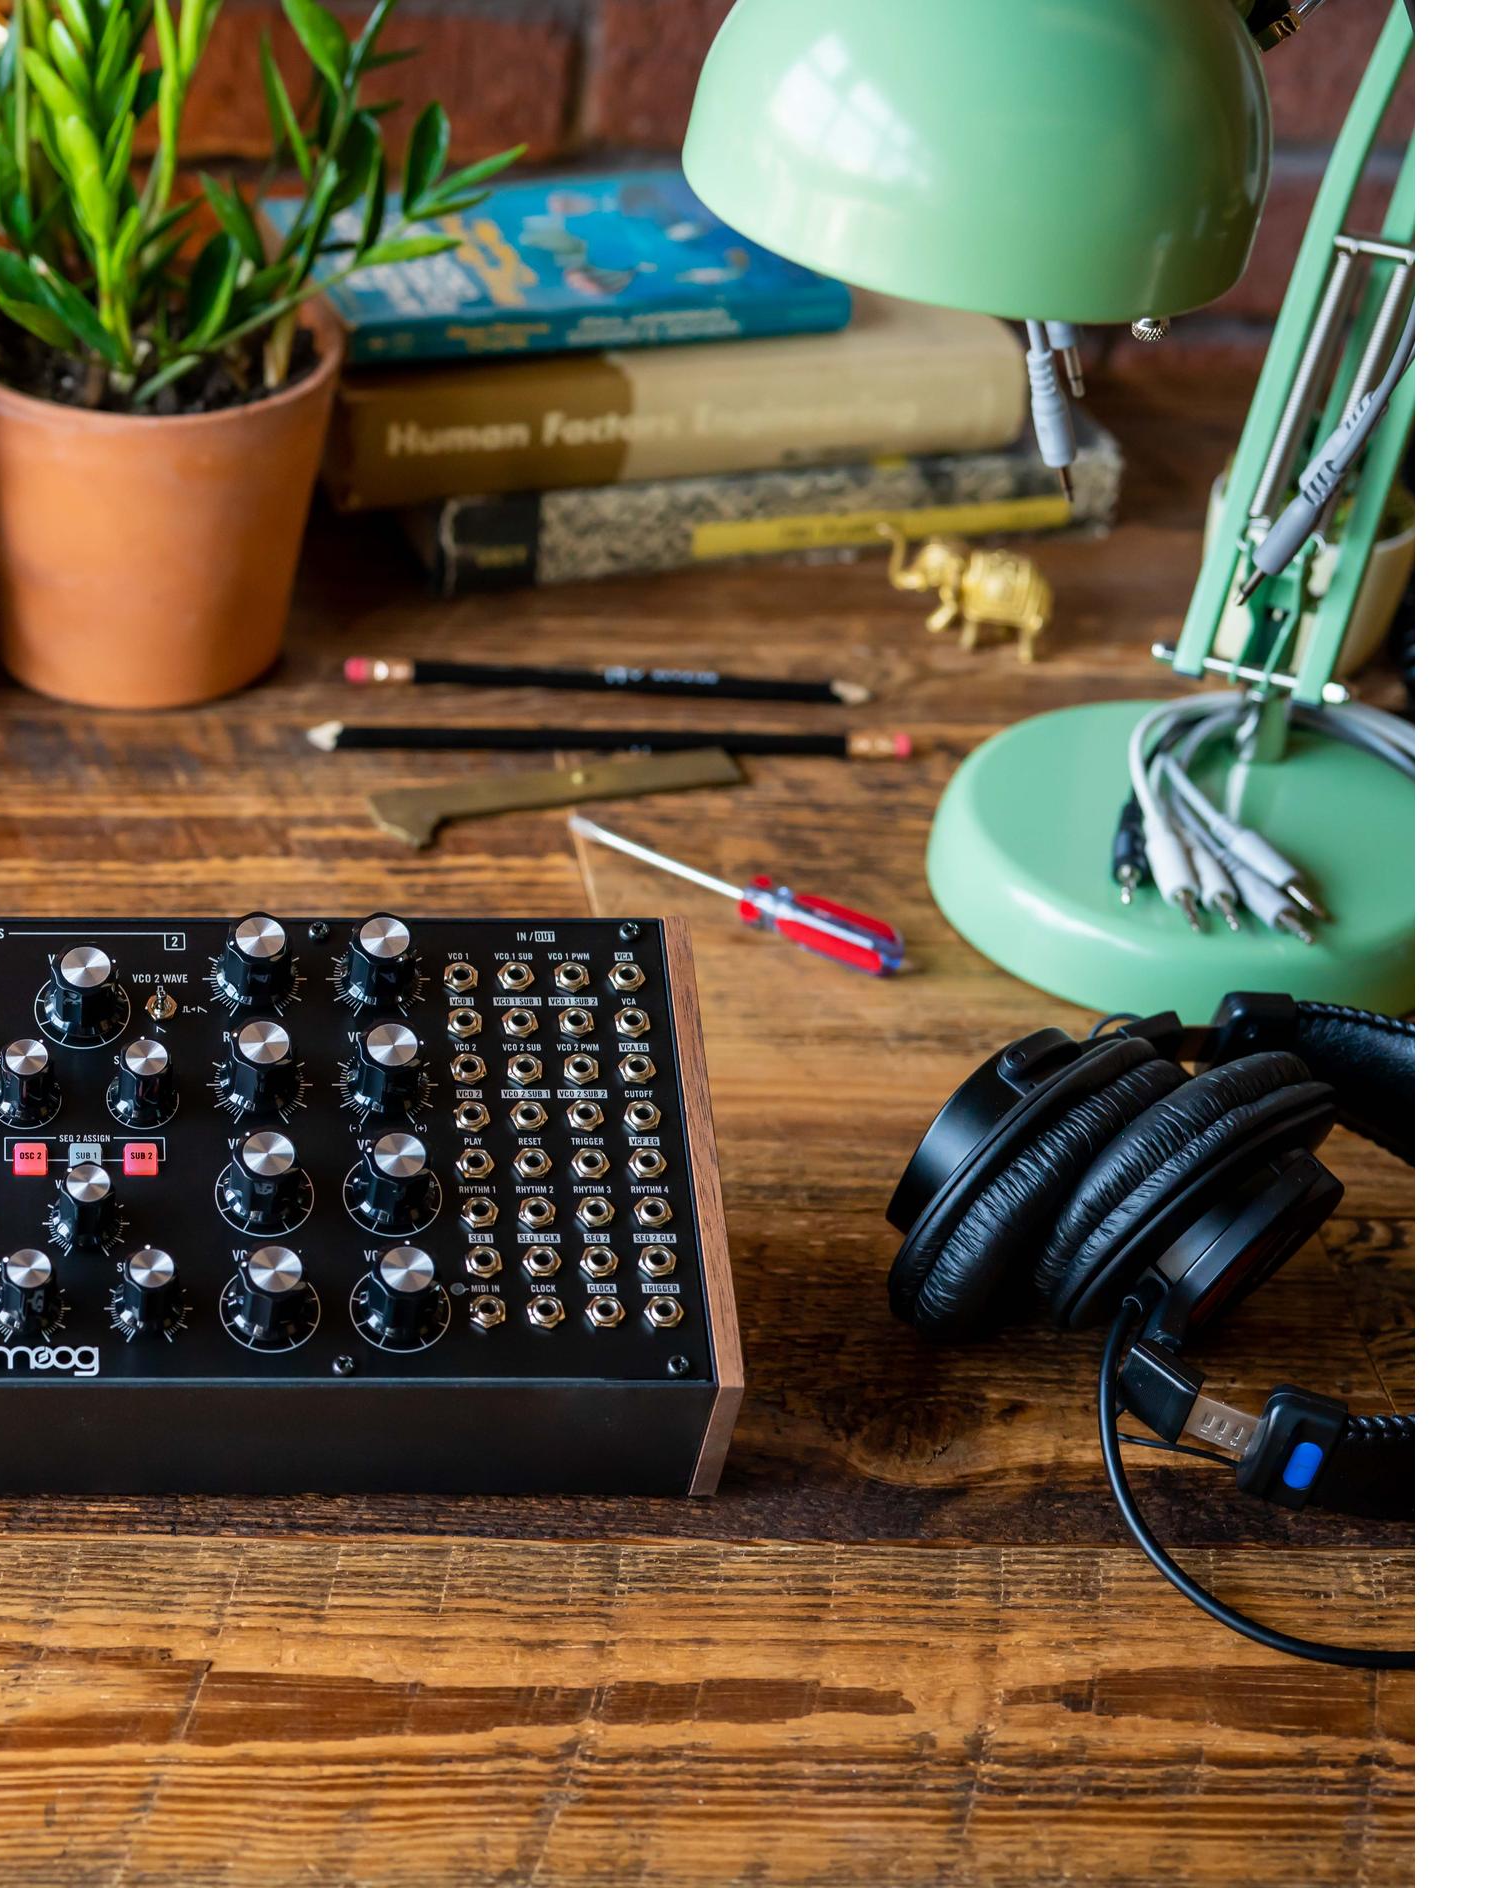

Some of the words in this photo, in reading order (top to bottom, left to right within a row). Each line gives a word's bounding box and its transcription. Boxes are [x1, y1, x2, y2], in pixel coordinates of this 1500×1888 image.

[387, 419, 529, 458] Human
[516, 932, 528, 942] IN
[536, 932, 554, 942] OUT
[132, 974, 151, 983] VCO
[154, 974, 160, 983] 2
[163, 974, 188, 983] WAVE
[458, 1090, 474, 1098] VCO
[475, 1090, 481, 1098] 2
[503, 1090, 519, 1098] VCO
[520, 1090, 526, 1098] 2
[527, 1090, 543, 1098] SUB
[545, 1090, 549, 1098] 1
[559, 1090, 575, 1098] VCO
[576, 1090, 582, 1098] 2
[583, 1090, 599, 1098] SUB
[600, 1090, 606, 1098] 2
[624, 1090, 653, 1098] CUTOFF
[59, 1134, 75, 1143] SEQ
[76, 1134, 81, 1142] 2
[83, 1134, 111, 1142] ASSIGN
[464, 1138, 483, 1146] PLAY
[518, 1138, 542, 1146] RESET
[571, 1138, 604, 1146] TRIGGER
[630, 1138, 646, 1146] VCF
[647, 1138, 658, 1146] EG
[19, 1152, 35, 1160] OSC
[36, 1152, 42, 1160] 2
[75, 1152, 91, 1160] SUB
[93, 1152, 97, 1160] 1
[130, 1152, 146, 1160] SUB
[147, 1152, 153, 1160] 2
[459, 1186, 490, 1194] RHYTHM
[492, 1186, 496, 1194] 1
[515, 1186, 547, 1194] RHYTHM
[548, 1186, 554, 1194] 2
[573, 1186, 604, 1194] RHYTHM
[605, 1186, 611, 1194] 3
[630, 1186, 662, 1194] RHYTHM
[663, 1186, 669, 1194] 4
[470, 1234, 486, 1242] SEQ
[488, 1234, 493, 1242] 1
[519, 1234, 535, 1242] SEQ
[537, 1234, 541, 1242] 1
[544, 1234, 559, 1242] CLK
[586, 1234, 601, 1242] SEQ
[603, 1234, 609, 1242] 2
[635, 1234, 651, 1242] SEQ
[652, 1234, 658, 1242] 2
[660, 1234, 675, 1242] CLK
[471, 1285, 489, 1293] MIDI
[491, 1285, 500, 1293] IN
[531, 1285, 556, 1293] CLOCK
[589, 1285, 615, 1293] CLOCK
[643, 1285, 678, 1293] TRIGGER
